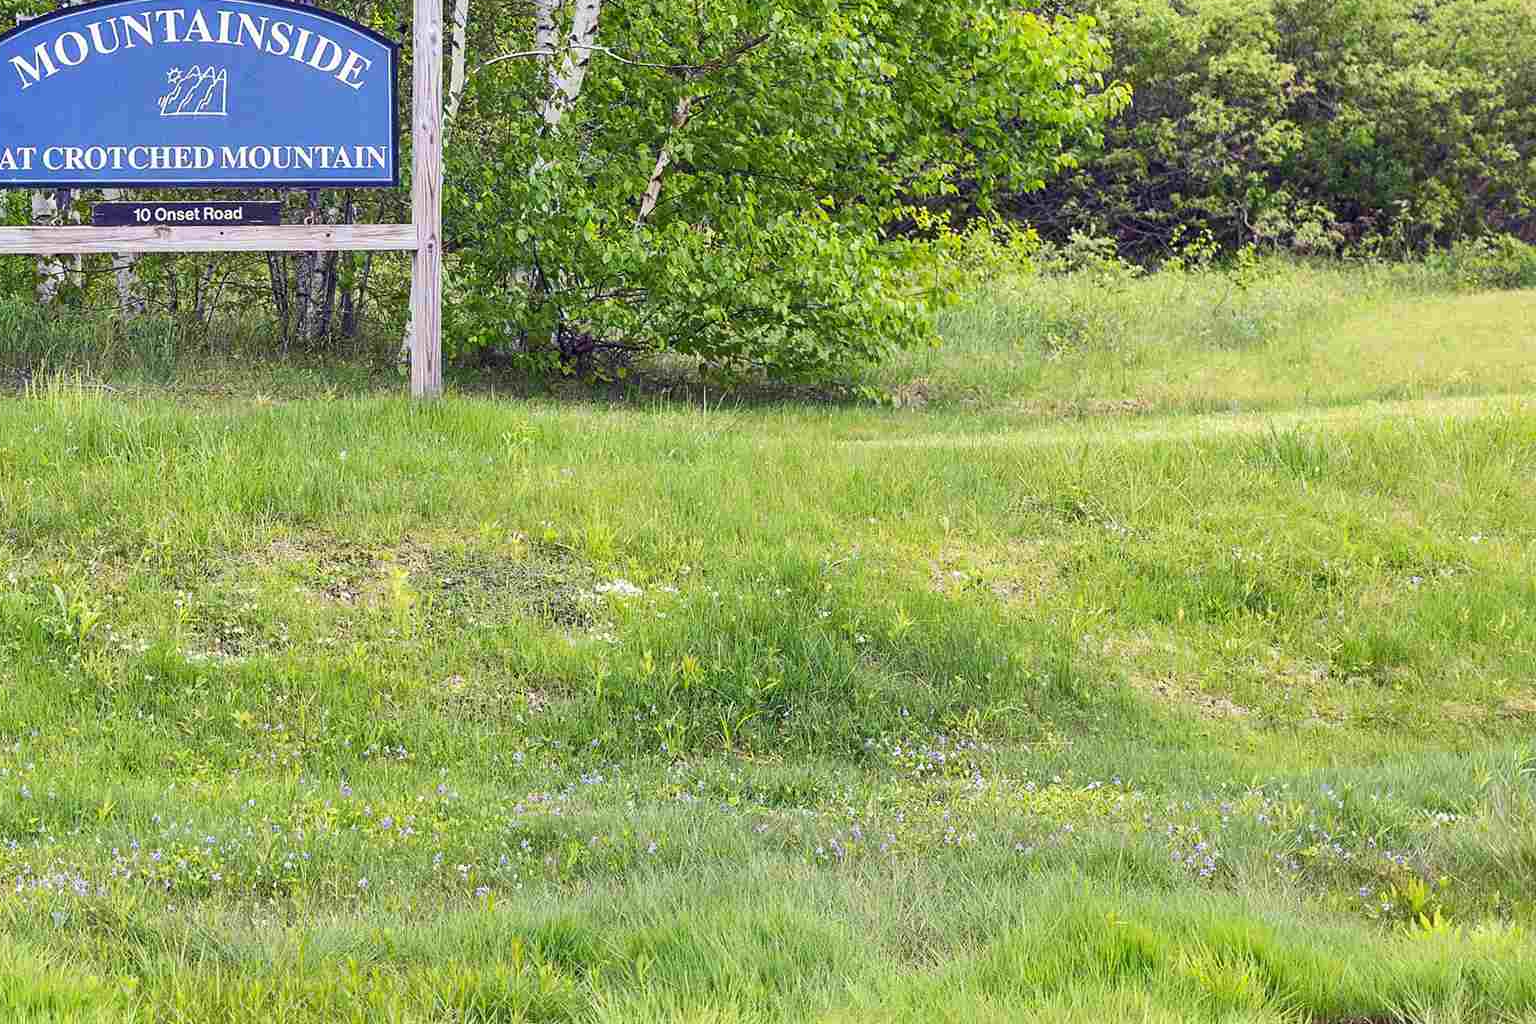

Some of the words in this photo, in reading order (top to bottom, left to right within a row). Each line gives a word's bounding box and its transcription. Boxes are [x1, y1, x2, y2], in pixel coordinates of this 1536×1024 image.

[8, 8, 373, 90] MOUNTAINSIDE
[42, 145, 215, 171] CROTCHED
[218, 145, 387, 171] MOUNTAIN
[133, 207, 151, 222] 10
[154, 206, 200, 222] Onset
[203, 205, 243, 221] Road
